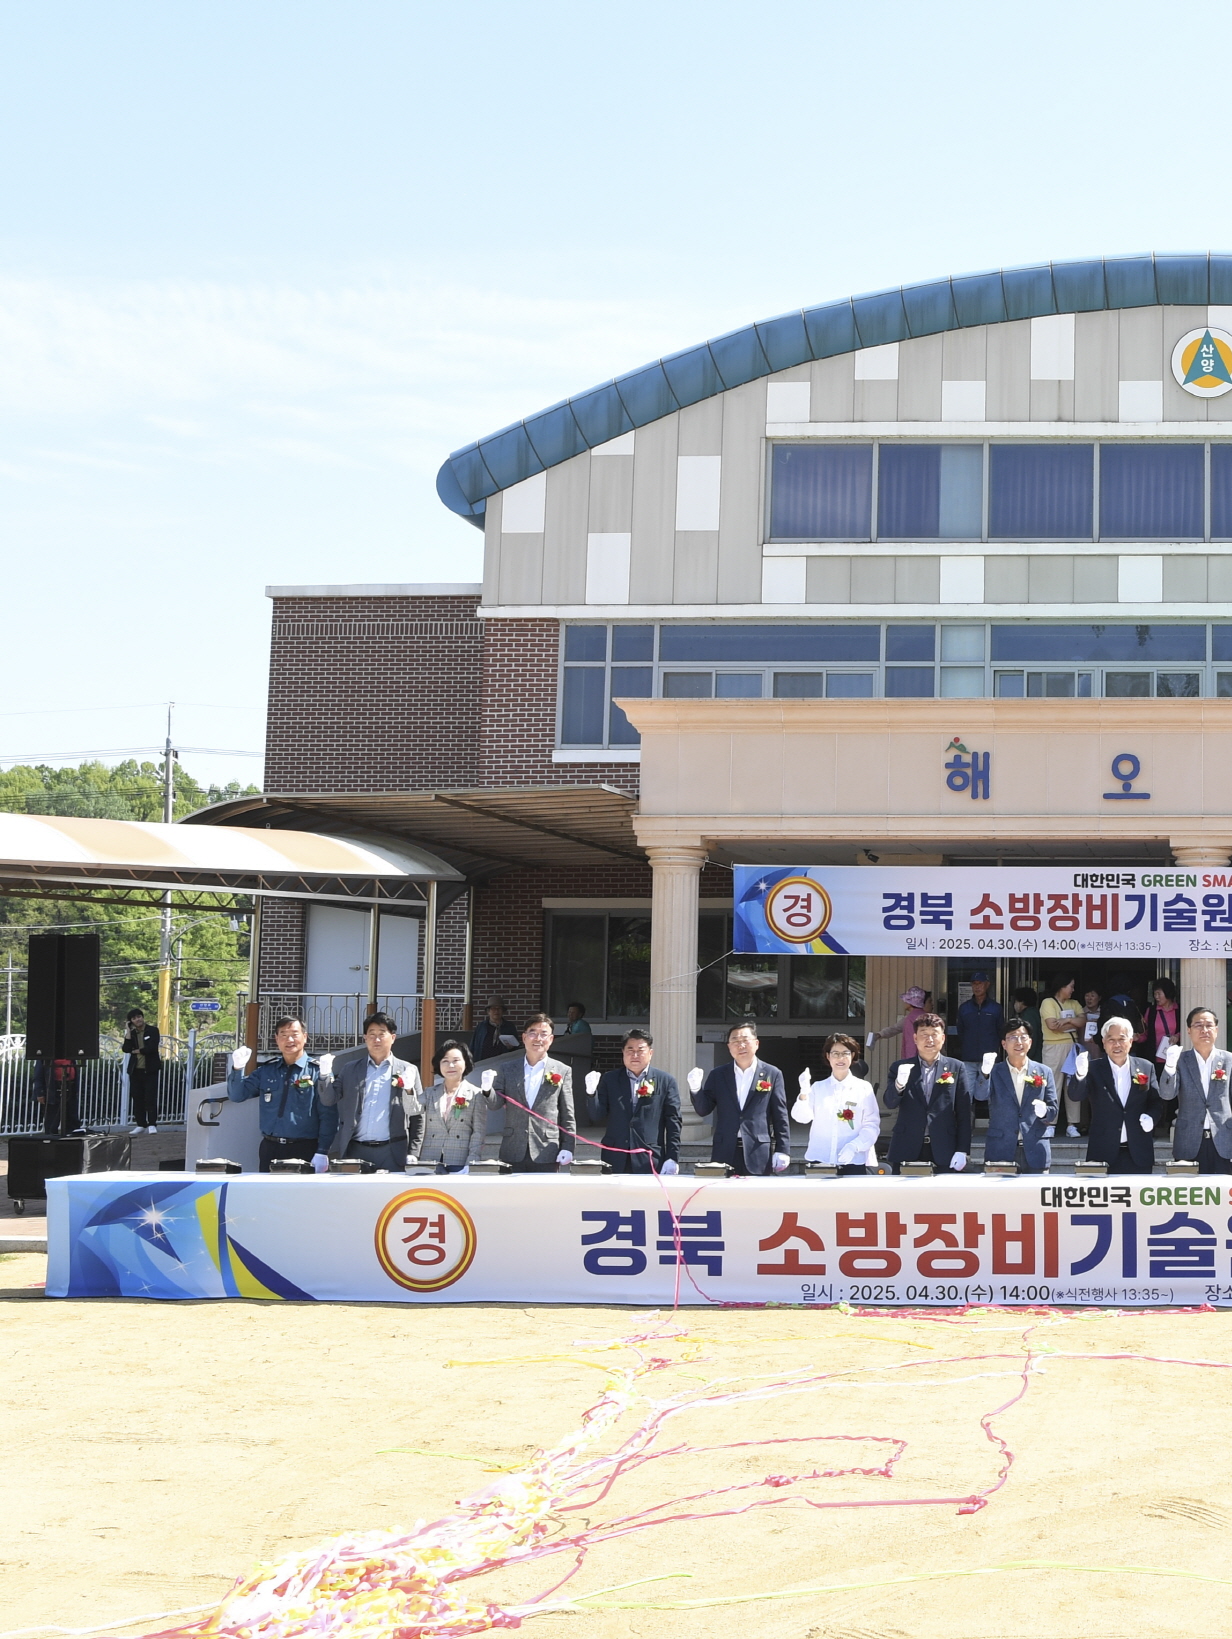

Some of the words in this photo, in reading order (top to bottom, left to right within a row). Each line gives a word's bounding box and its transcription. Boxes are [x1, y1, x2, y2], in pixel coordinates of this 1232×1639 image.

[1200, 344, 1215, 373] 산양
[1073, 872, 1137, 889] 대한민국
[1141, 873, 1197, 888] GREEN
[781, 894, 813, 928] 경
[881, 892, 954, 931] 경북
[905, 937, 929, 951] 일시
[938, 938, 974, 950] 2025.
[977, 938, 1038, 953] 04.30.(수)
[1188, 938, 1213, 952] 장소
[1040, 1186, 1132, 1208] 대한민국
[1139, 1186, 1221, 1207] GREEN
[401, 1212, 447, 1266] 경
[580, 1209, 726, 1277] 경북
[800, 1283, 834, 1302] 일시
[849, 1284, 901, 1301] 2025.
[905, 1283, 994, 1304] 04.30.(수)
